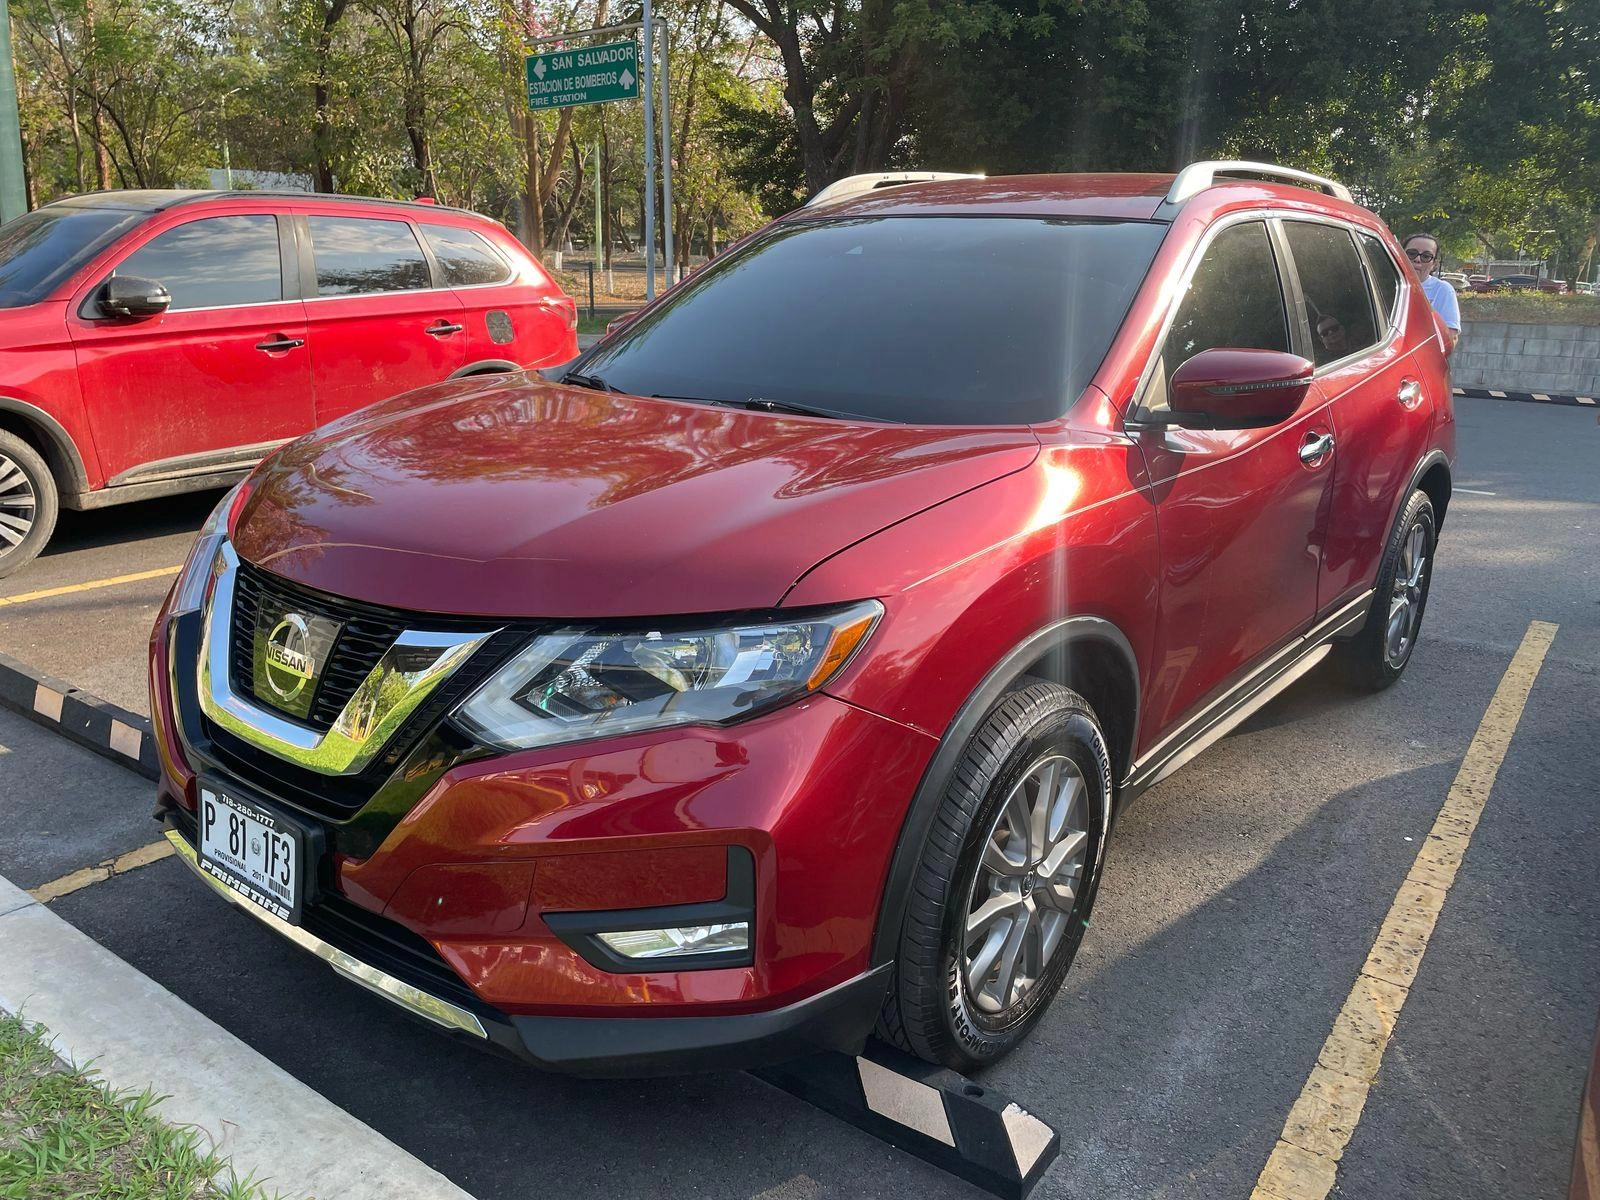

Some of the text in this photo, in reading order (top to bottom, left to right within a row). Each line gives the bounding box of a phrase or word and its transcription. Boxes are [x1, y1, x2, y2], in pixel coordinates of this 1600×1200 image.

[552, 46, 634, 71] SAN SALVADOR
[529, 71, 617, 95] ESTACION DE BOMBEROS
[530, 91, 587, 107] FIRE STATION
[266, 644, 307, 673] NISSAN
[222, 793, 275, 827] 718-280-1777
[204, 800, 216, 842] P
[229, 812, 247, 861] 81
[262, 830, 291, 887] 1F3
[213, 848, 248, 873] PROVISIONAL
